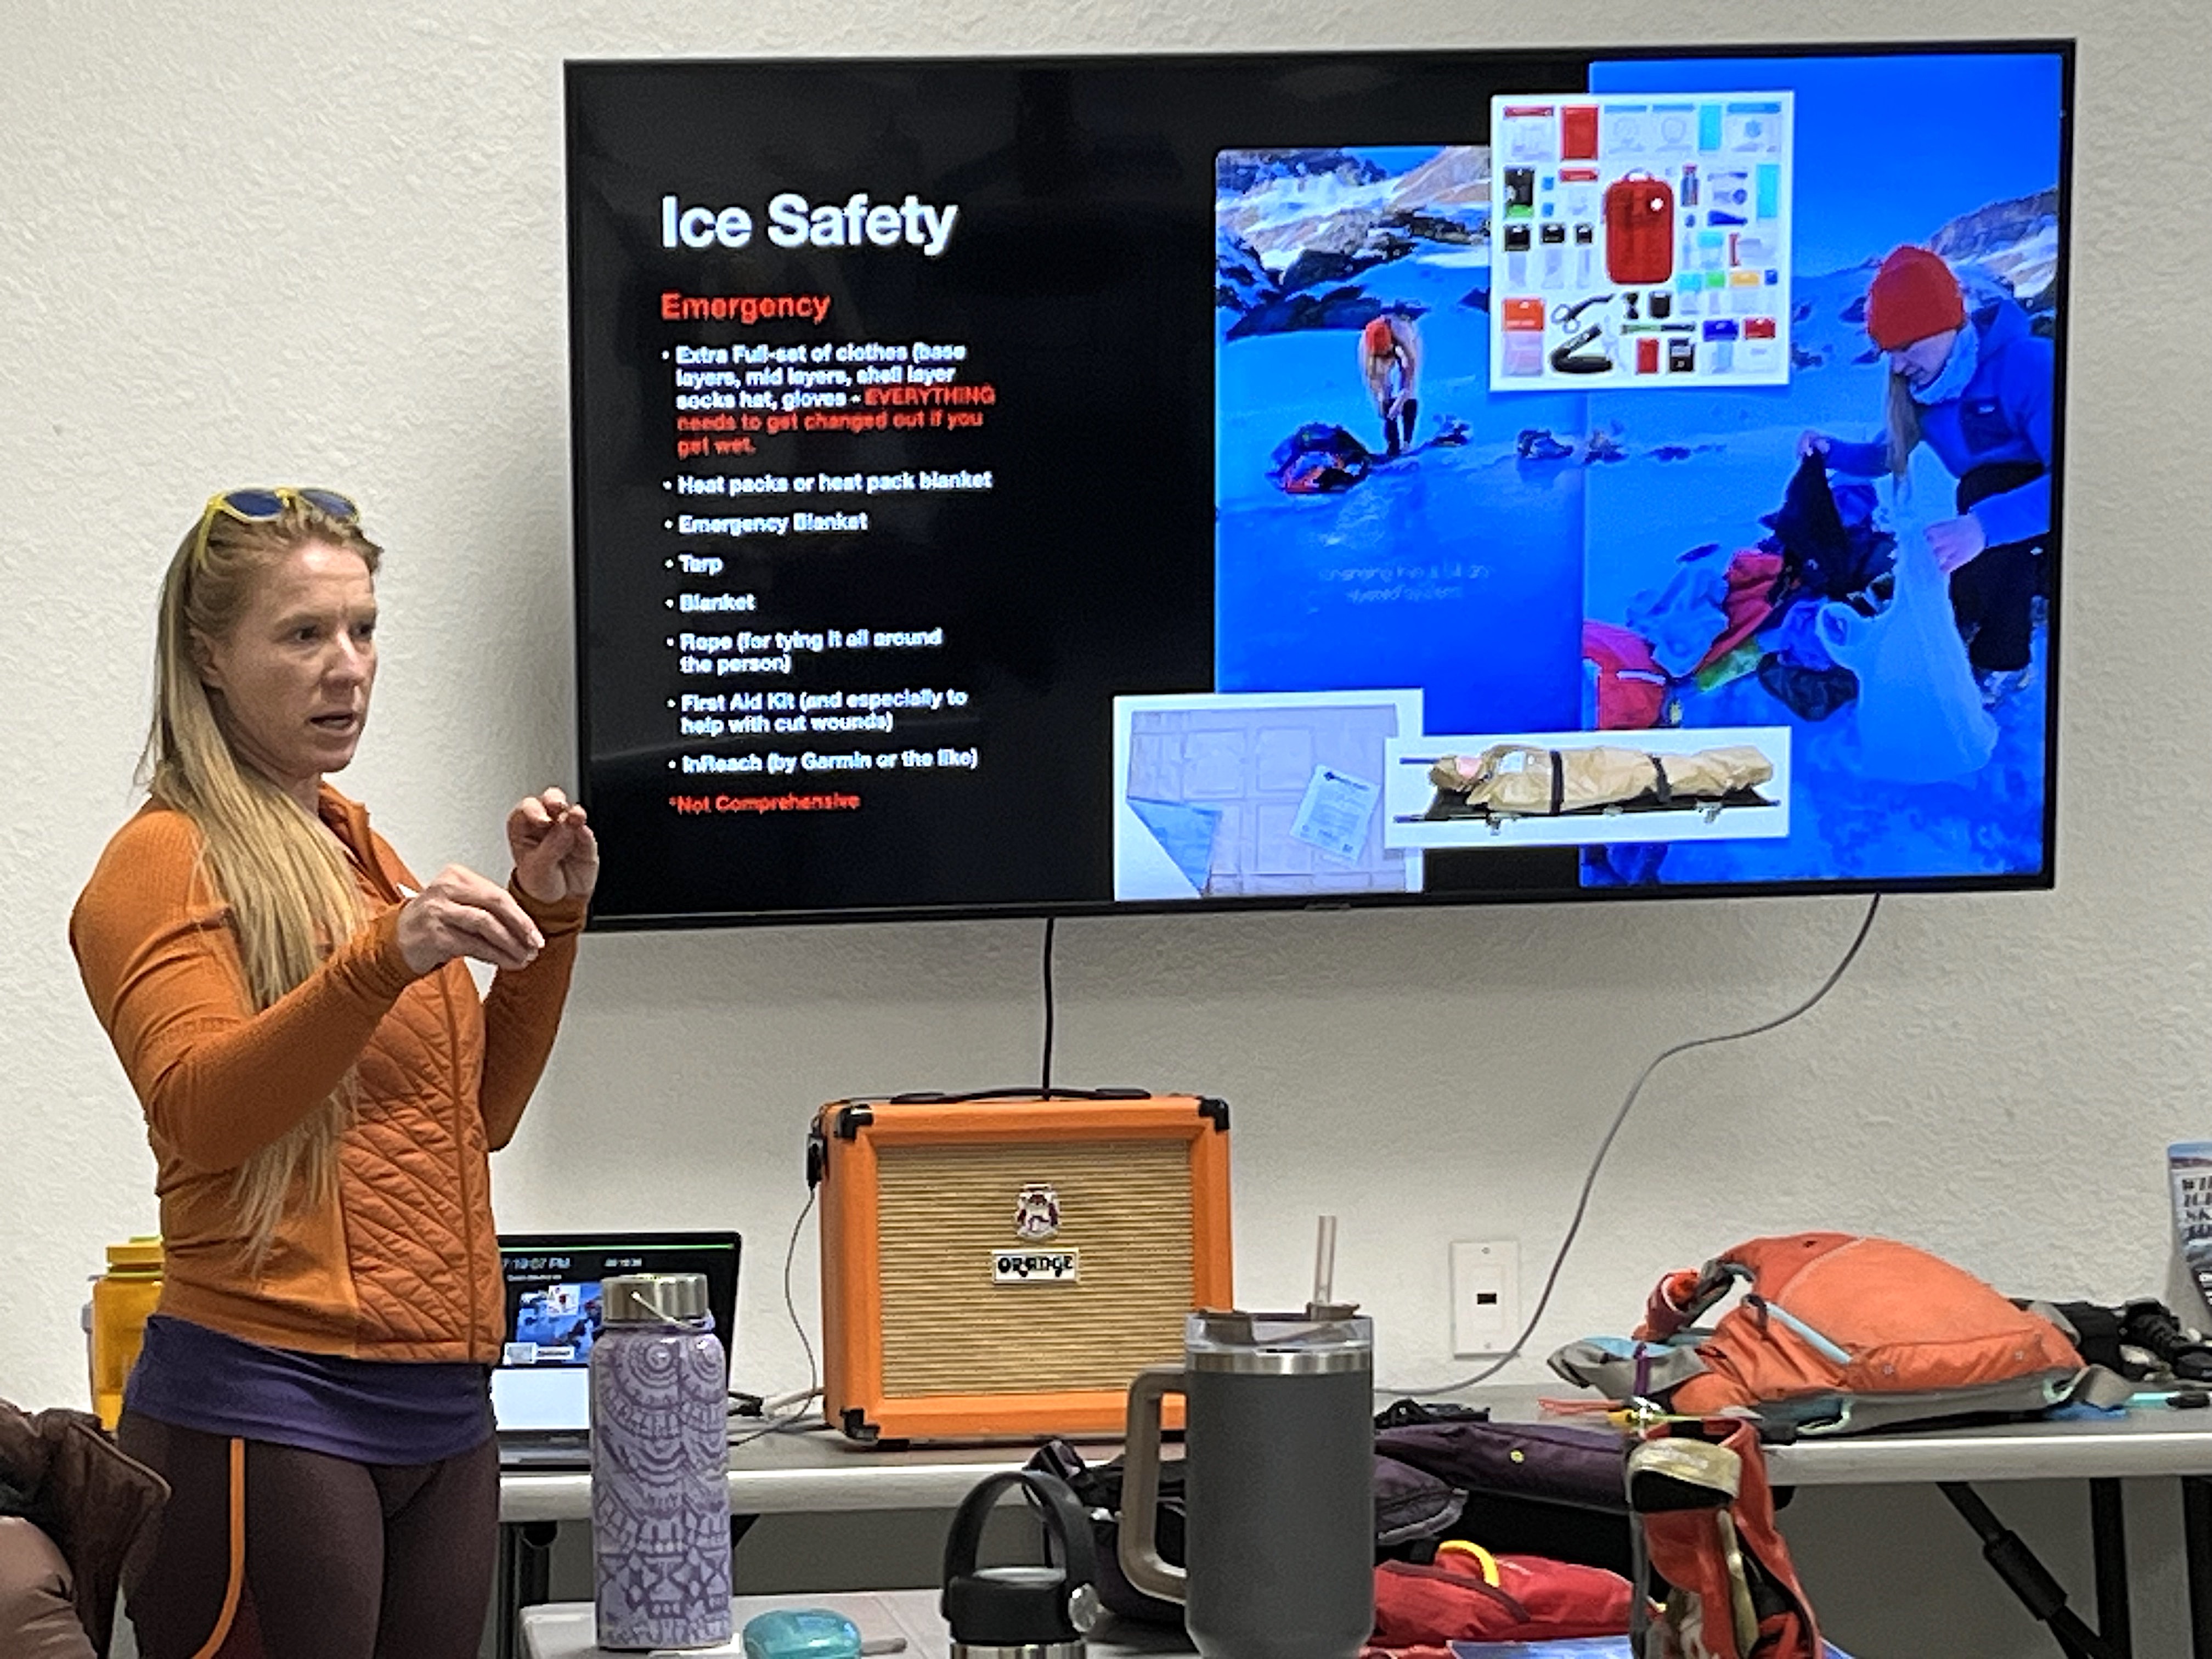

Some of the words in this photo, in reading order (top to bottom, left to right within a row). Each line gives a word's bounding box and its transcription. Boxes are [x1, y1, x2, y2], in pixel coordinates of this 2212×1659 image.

[663, 196, 752, 247] Ice
[768, 194, 958, 256] Safety
[662, 293, 830, 324] Emergency
[676, 345, 728, 364] Extra
[732, 344, 807, 363] Full-set
[811, 343, 832, 362] of
[836, 343, 908, 362] clothes
[912, 342, 966, 362] (base
[676, 368, 741, 388] layers,
[746, 367, 783, 385] mid
[787, 367, 852, 387] layers,
[856, 365, 902, 384] shell
[907, 365, 956, 386] layer
[676, 391, 736, 409] socks
[740, 390, 778, 411] hat,
[782, 389, 847, 411] gloves
[865, 386, 996, 405] EVERYTHING
[678, 413, 737, 431] needs
[741, 413, 761, 430] to
[766, 413, 798, 433] get
[804, 411, 888, 433] changed
[893, 410, 925, 428] out
[930, 409, 943, 427] if
[947, 413, 983, 431] you
[678, 437, 709, 458] get
[714, 437, 756, 454] wet.
[678, 476, 727, 494] Heat
[730, 474, 788, 496] packs
[793, 476, 815, 490] or
[818, 473, 863, 490] heat
[867, 472, 915, 493] pack
[919, 471, 993, 489] blanket
[679, 515, 789, 537] Emergency
[793, 512, 869, 532] Blanket
[678, 554, 724, 575] Tarp
[680, 593, 756, 612] Blanket
[680, 633, 732, 653] Rope
[737, 631, 771, 652] (for
[775, 631, 823, 652] tying
[828, 630, 842, 648] it
[846, 629, 869, 647] all
[873, 628, 943, 646] around
[680, 654, 712, 673] the
[717, 654, 792, 676] person)
[681, 694, 725, 712] First
[730, 693, 763, 711] Aid
[768, 692, 795, 709] Kit
[799, 691, 843, 710] (and
[846, 689, 943, 710] especially
[946, 689, 969, 706] to
[681, 716, 724, 737] help
[727, 715, 771, 733] with
[774, 714, 806, 732] cut
[810, 713, 894, 732] wounds)
[682, 755, 763, 774] InReach
[768, 753, 797, 774] (by
[802, 752, 872, 770] Garmin
[876, 754, 897, 769] or
[901, 750, 933, 767] the
[937, 748, 978, 770] like)
[715, 793, 860, 814] Comprehensive
